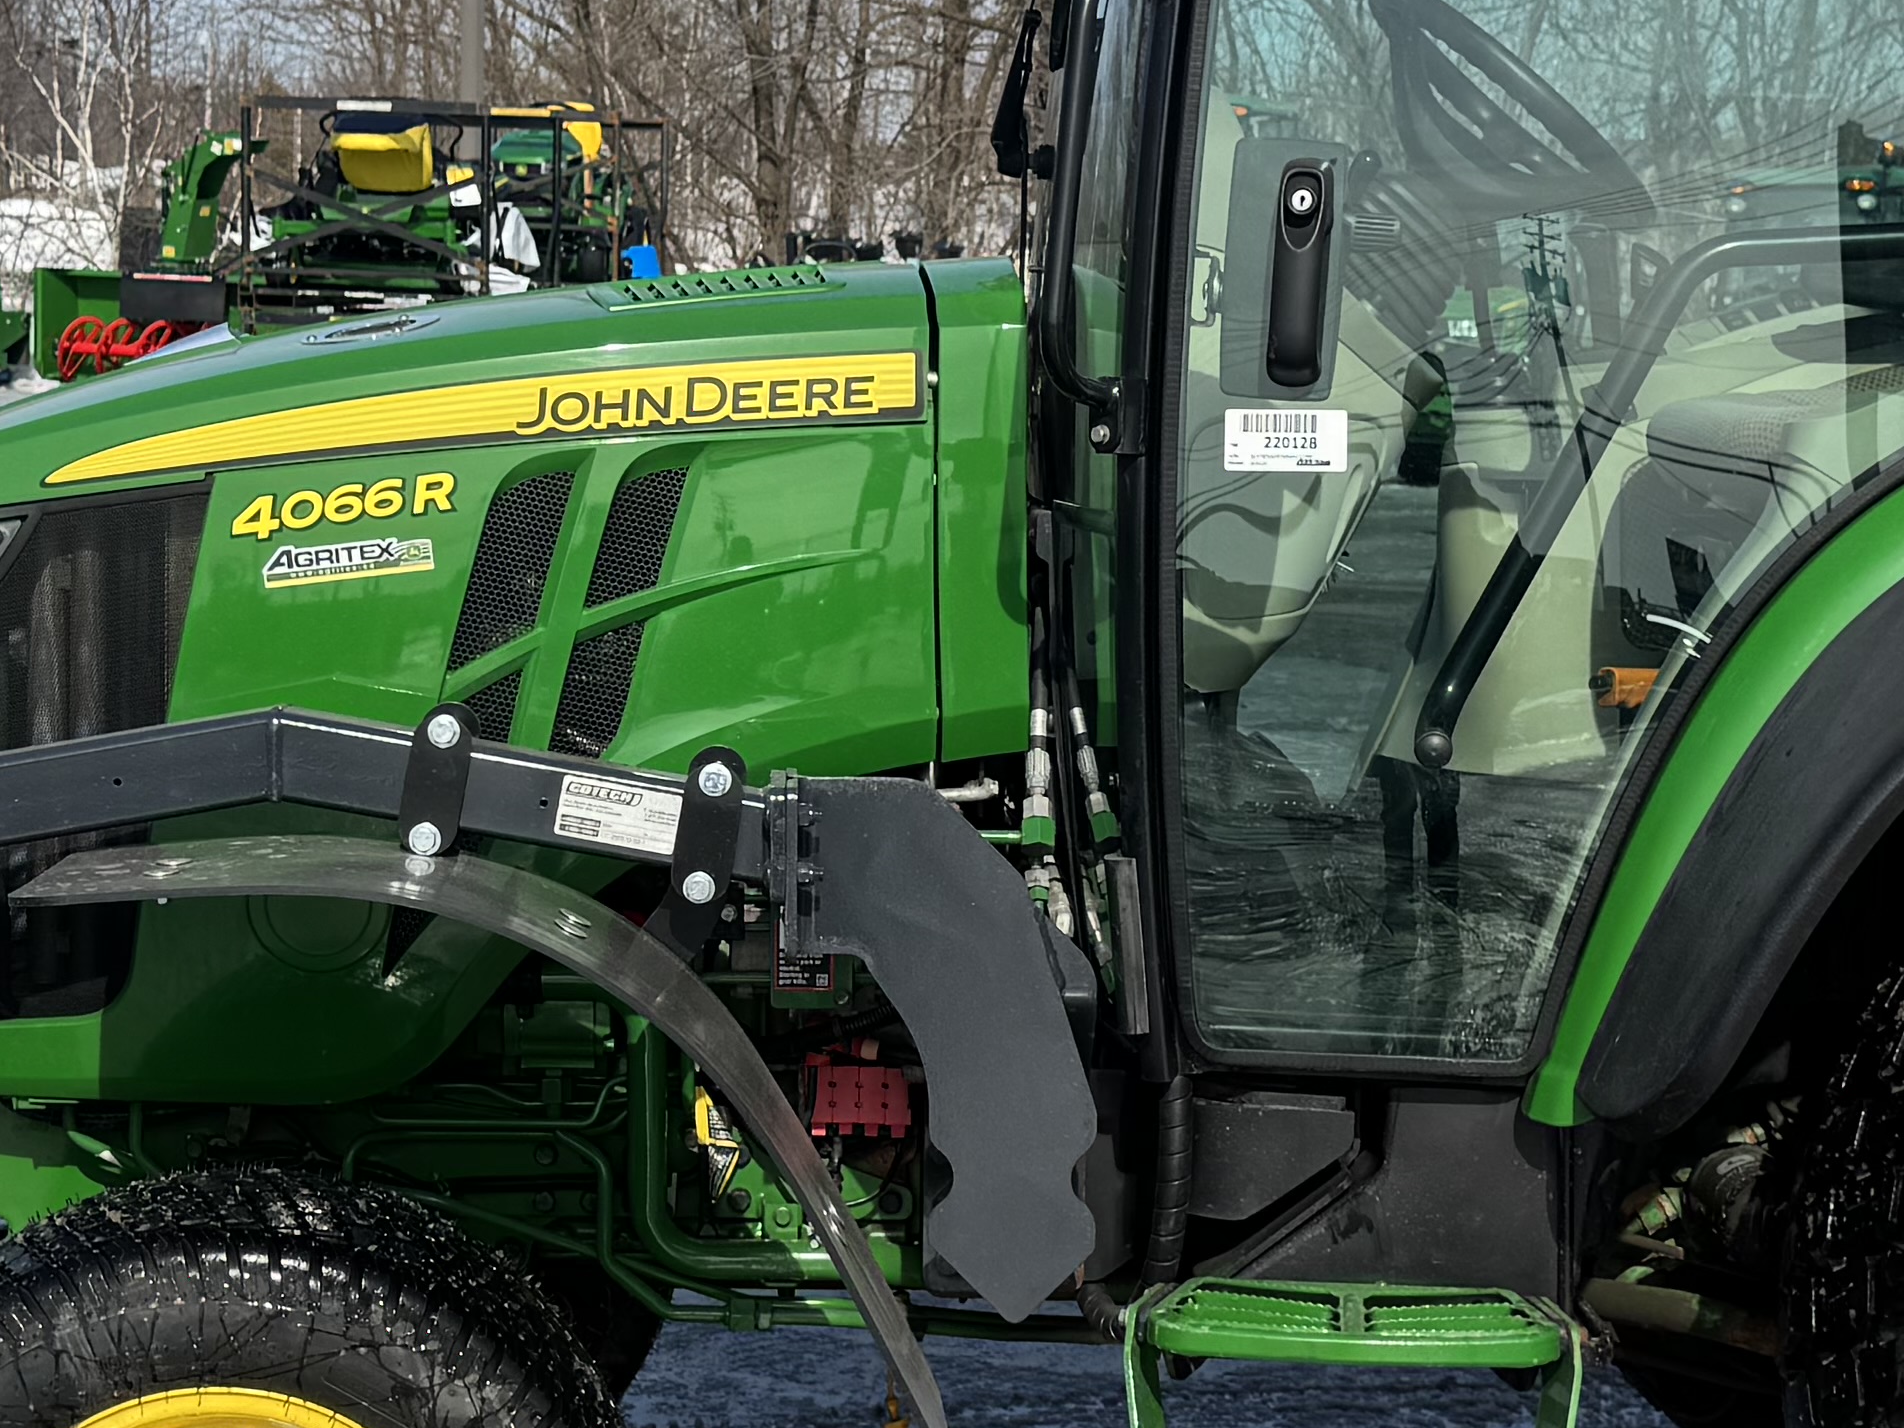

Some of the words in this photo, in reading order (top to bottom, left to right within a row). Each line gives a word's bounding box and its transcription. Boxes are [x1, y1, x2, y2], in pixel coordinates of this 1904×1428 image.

[515, 386, 673, 429] JOHN
[685, 375, 876, 418] DEERE
[1263, 436, 1318, 450] 220128
[230, 478, 404, 540] 4066
[412, 472, 457, 515] R
[267, 541, 396, 572] AGRITEX
